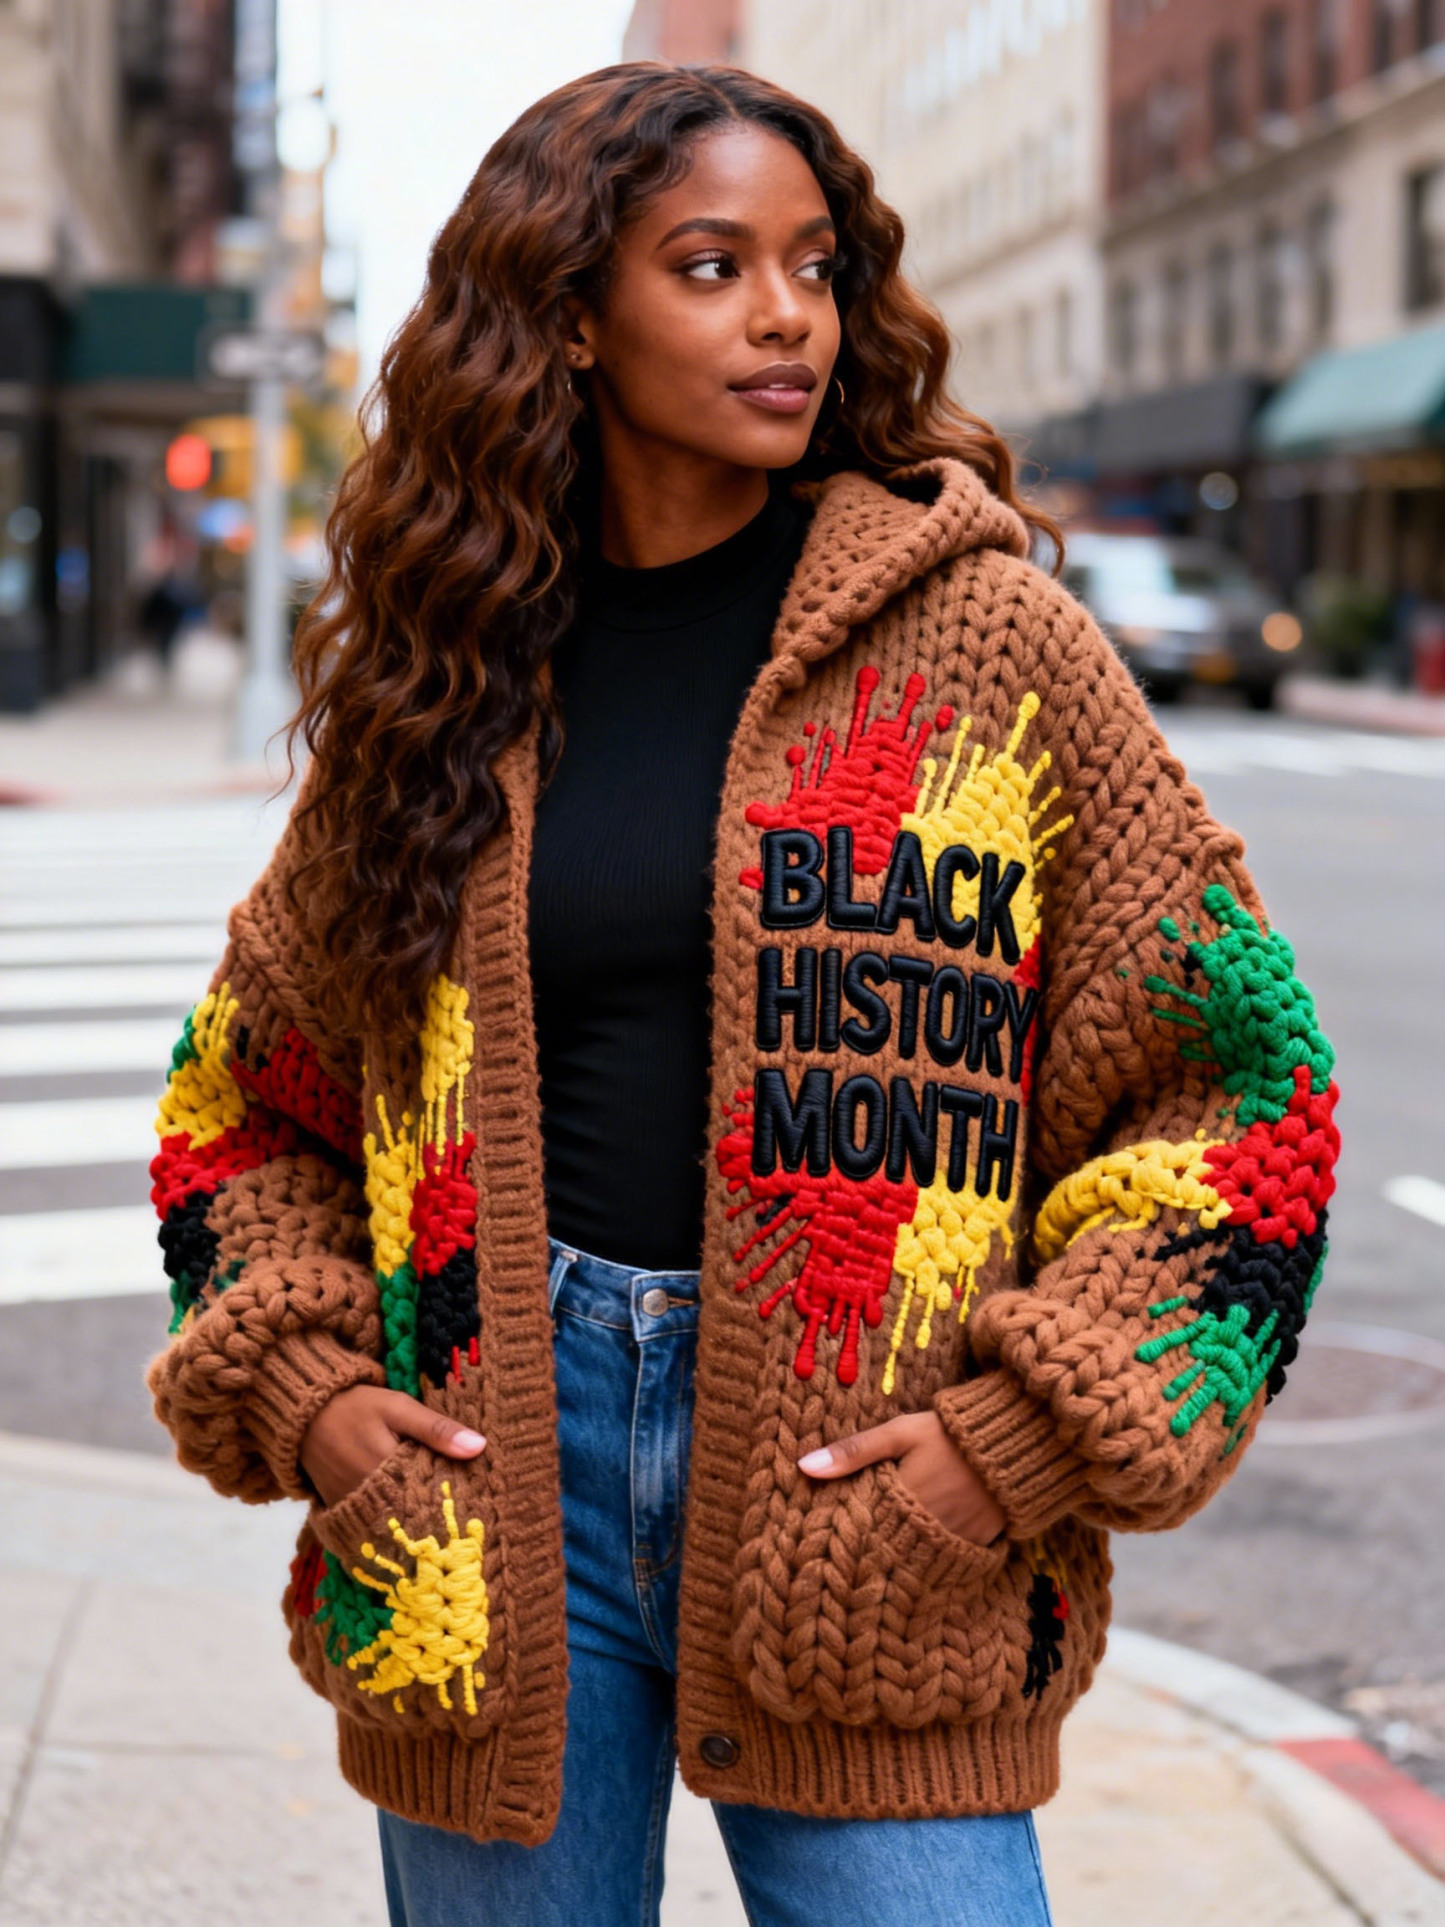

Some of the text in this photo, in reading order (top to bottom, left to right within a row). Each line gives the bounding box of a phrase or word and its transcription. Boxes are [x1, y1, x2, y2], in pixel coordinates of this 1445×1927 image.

[761, 827, 1026, 964] BLACK
[756, 948, 1038, 1083] HISTORY
[752, 1069, 1019, 1201] MONTH
